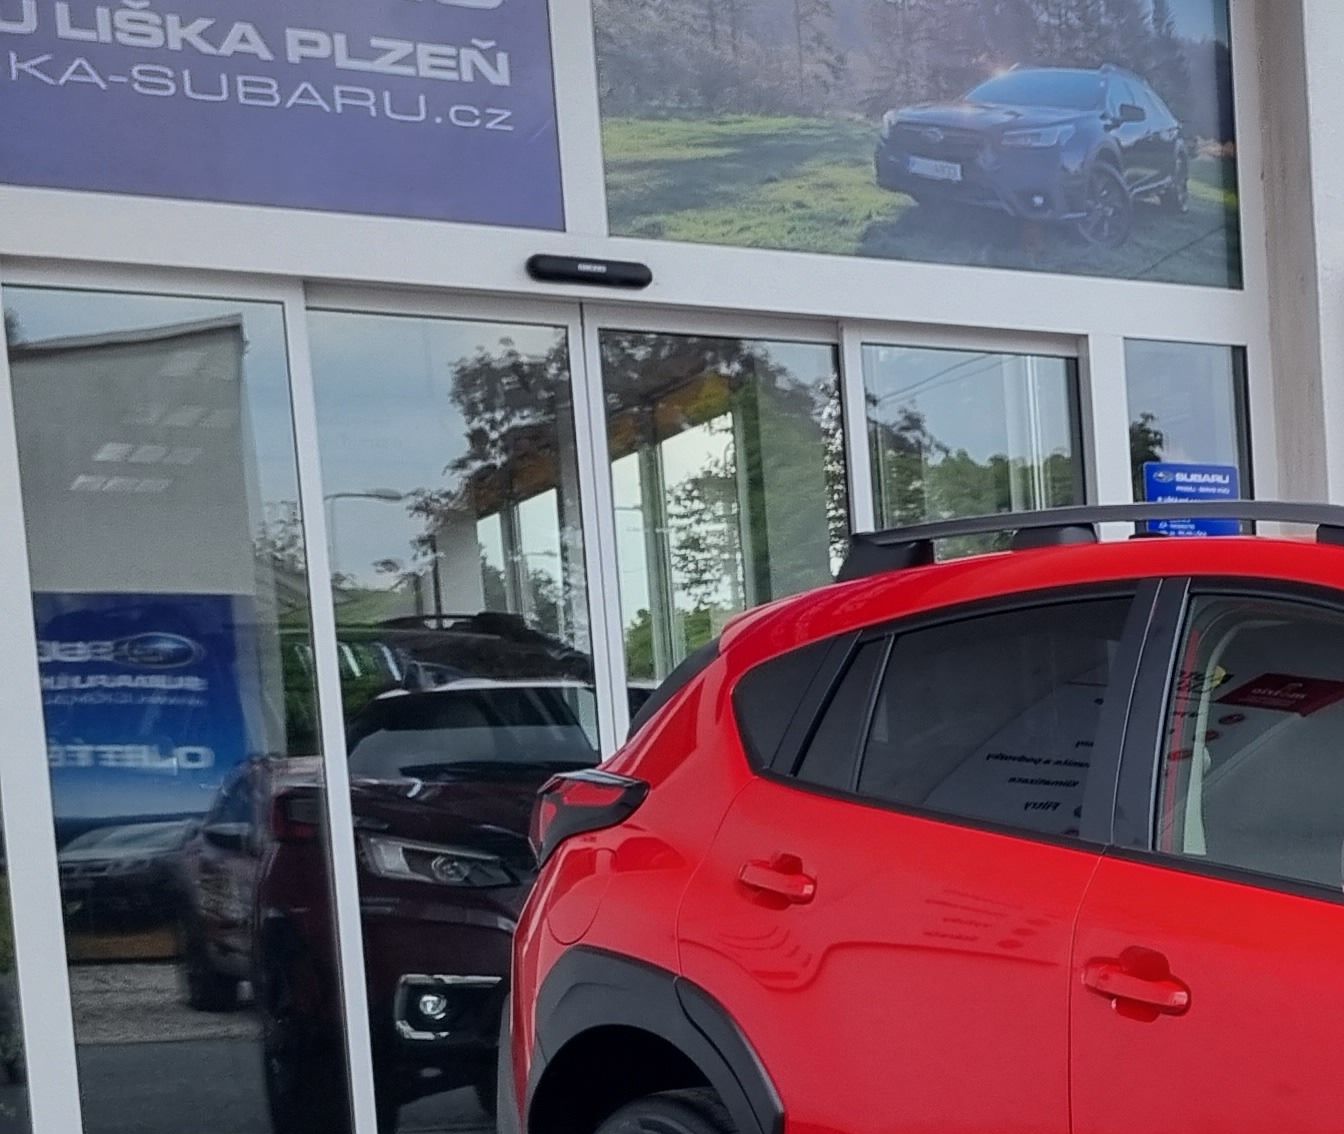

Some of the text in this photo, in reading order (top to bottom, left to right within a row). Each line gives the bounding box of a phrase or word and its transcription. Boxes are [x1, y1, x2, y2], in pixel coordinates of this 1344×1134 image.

[55, 0, 274, 61] LIŠKA
[285, 27, 511, 86] PLZEŇ
[9, 50, 514, 131] KA-SUBARU.cz
[1175, 472, 1230, 484] SUBARU
